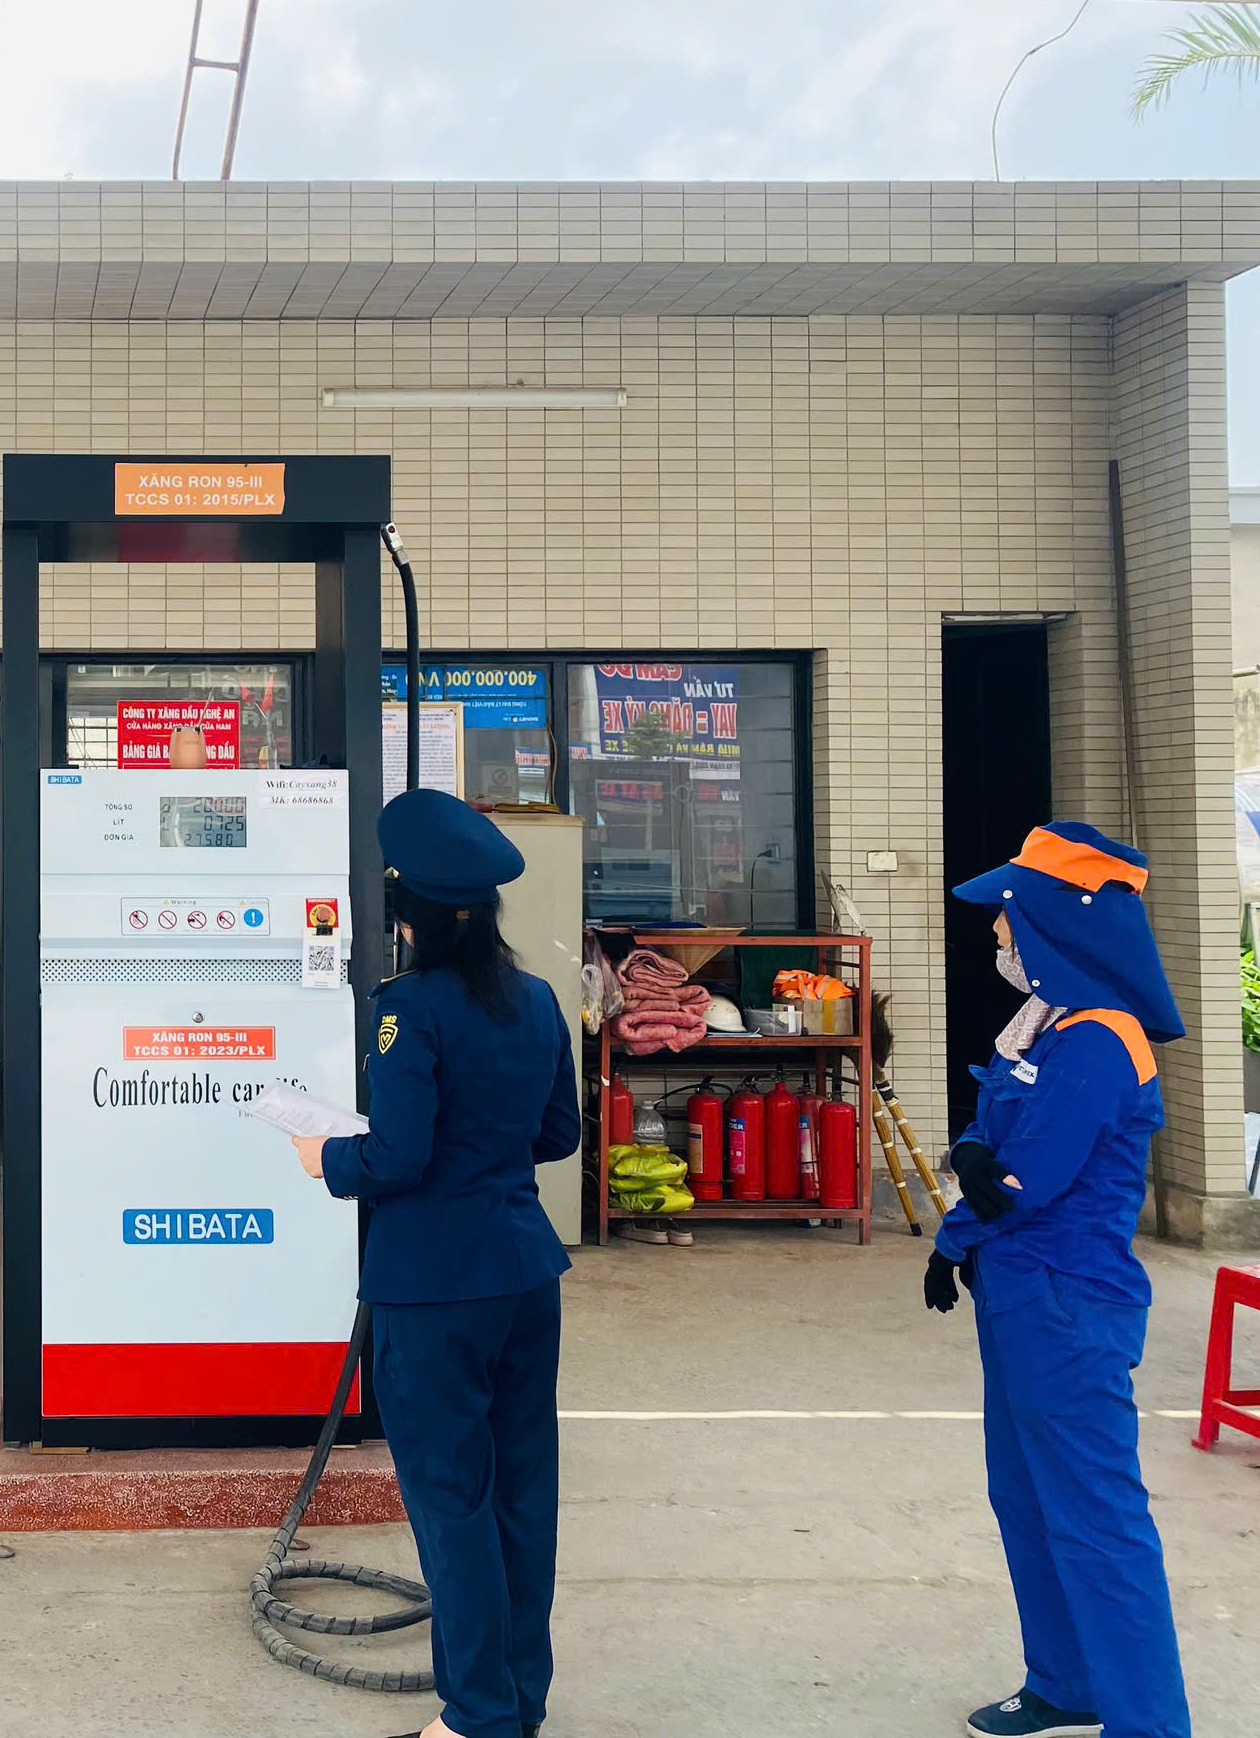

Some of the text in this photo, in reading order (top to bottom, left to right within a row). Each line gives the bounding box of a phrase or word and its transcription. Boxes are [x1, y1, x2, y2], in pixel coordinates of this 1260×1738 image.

[139, 473, 262, 488] XĂNG RON 95-III
[125, 493, 275, 506] TCCS 01: 2015/PLX
[122, 706, 144, 719] CÔNG
[146, 708, 157, 719] TY
[158, 707, 180, 720] XĂNG
[182, 705, 198, 720] DẦU
[223, 709, 235, 720] AN
[122, 740, 145, 759] BẢNG
[146, 741, 160, 759] GIÁ
[218, 741, 235, 760] DẦU
[49, 776, 80, 784] SHIBATA
[152, 1030, 247, 1042] XĂNG RON 95-III
[133, 1046, 266, 1056] TCCS 01: 2023/PLX
[93, 1066, 221, 1108] Comfortable
[232, 1081, 265, 1103] car
[134, 1213, 263, 1241] SHIBATA
